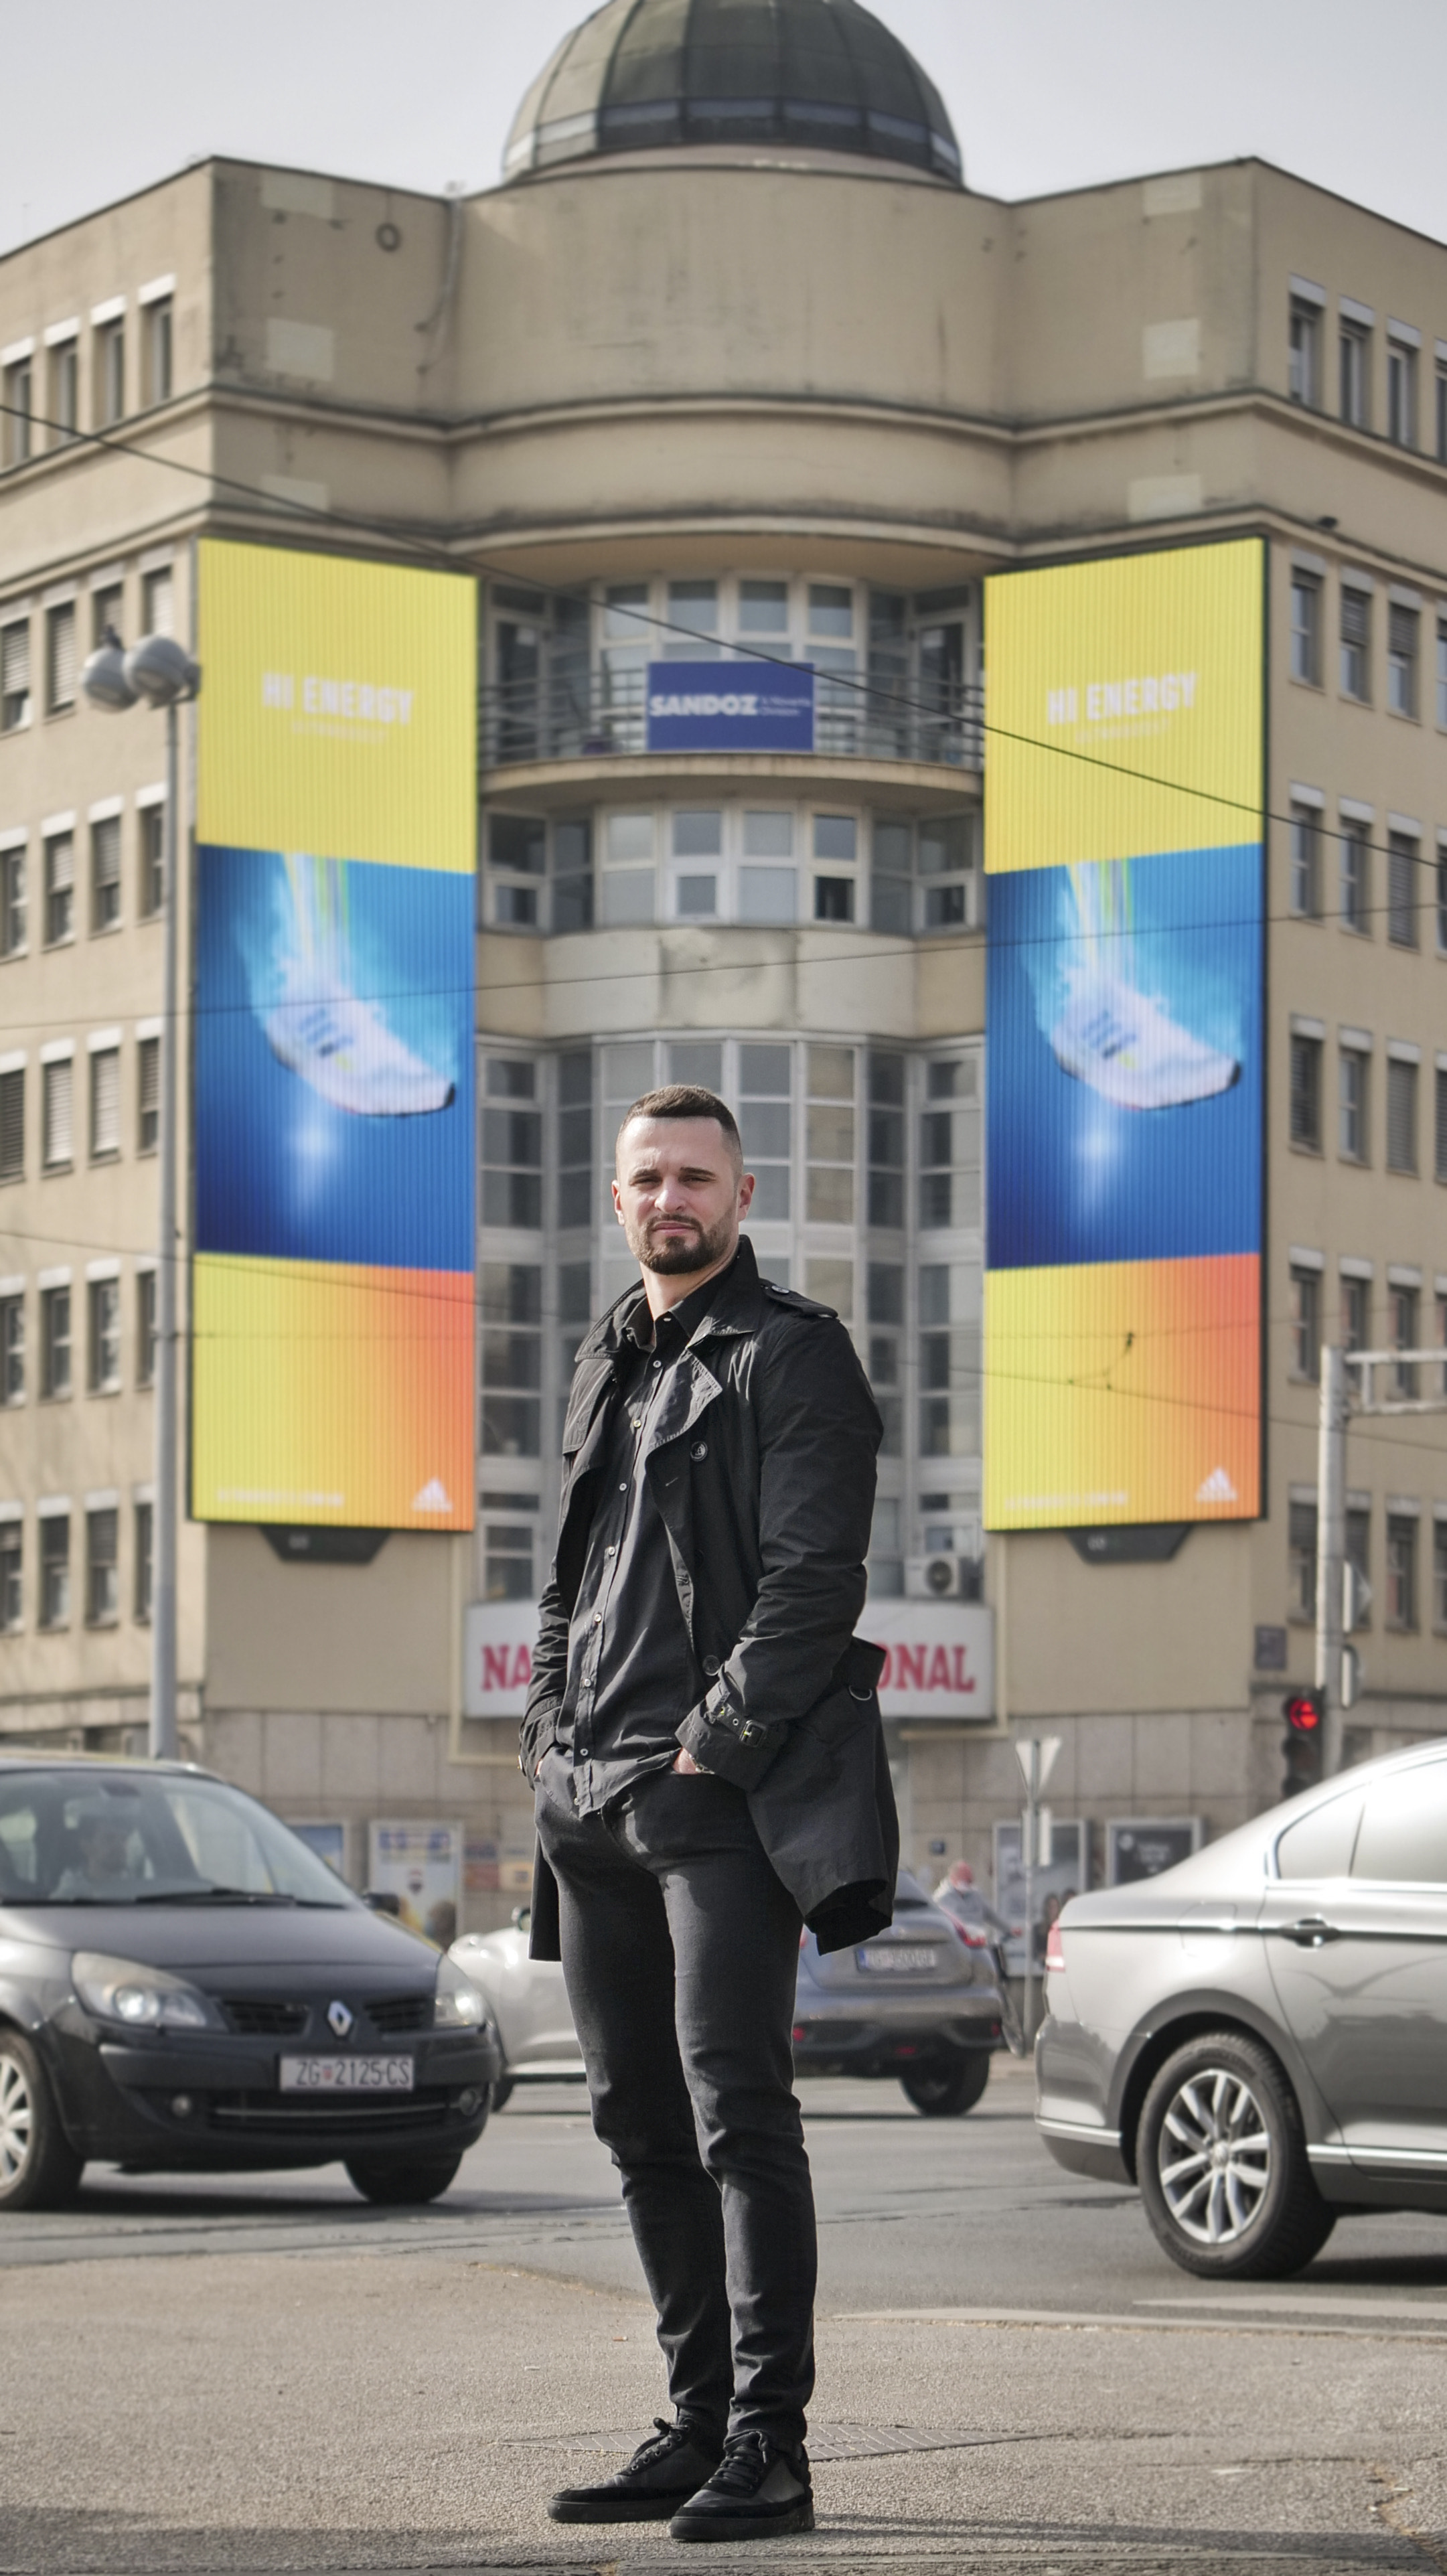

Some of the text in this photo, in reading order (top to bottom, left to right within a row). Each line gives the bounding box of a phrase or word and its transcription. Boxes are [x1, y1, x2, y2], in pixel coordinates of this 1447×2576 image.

[264, 672, 413, 724] HI ENERGY
[650, 695, 758, 716] SANDOZ
[1047, 671, 1197, 725] HI ENERGY
[297, 2060, 320, 2086] ZG
